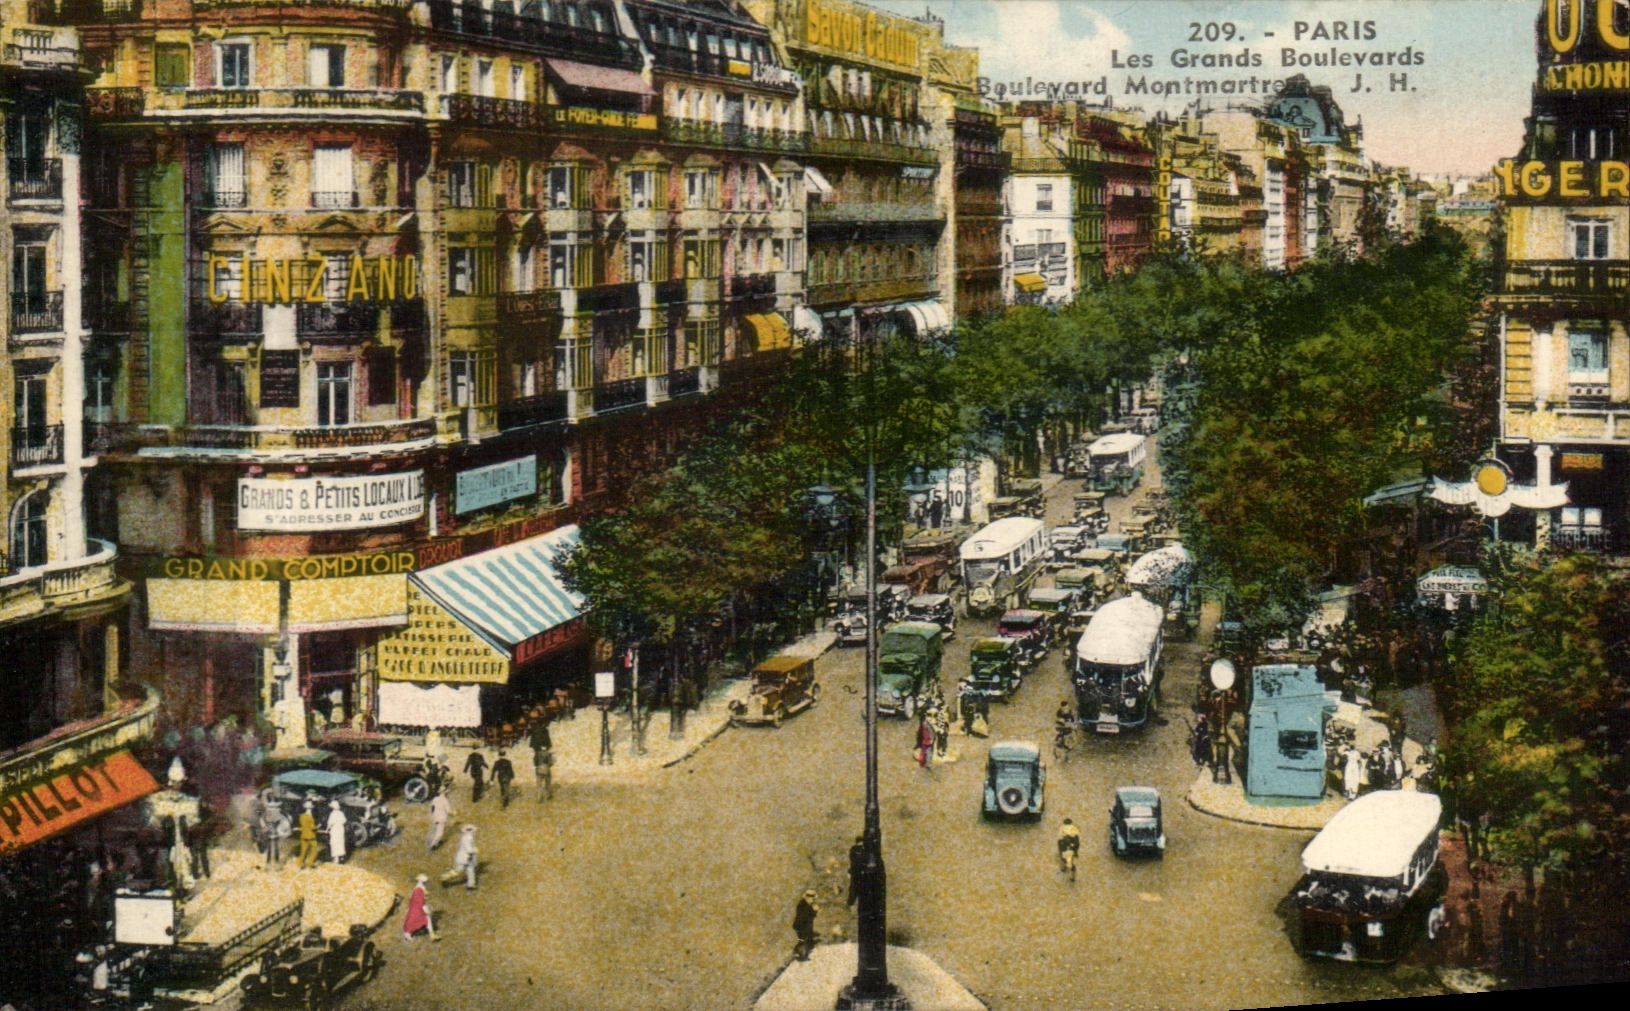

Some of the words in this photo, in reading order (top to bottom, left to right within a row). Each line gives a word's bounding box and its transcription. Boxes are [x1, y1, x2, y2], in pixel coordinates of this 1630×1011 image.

[807, 0, 860, 53] Savon
[208, 254, 417, 304] CINZANO
[240, 485, 294, 510] GRANDS
[315, 485, 361, 509] PETITS
[364, 479, 405, 507] LOCAUX
[949, 490, 963, 507] 10
[265, 514, 352, 525] S'ADRESSER
[359, 512, 374, 522] AU
[165, 558, 268, 580] GRAND
[284, 552, 416, 580] COMPTOIR
